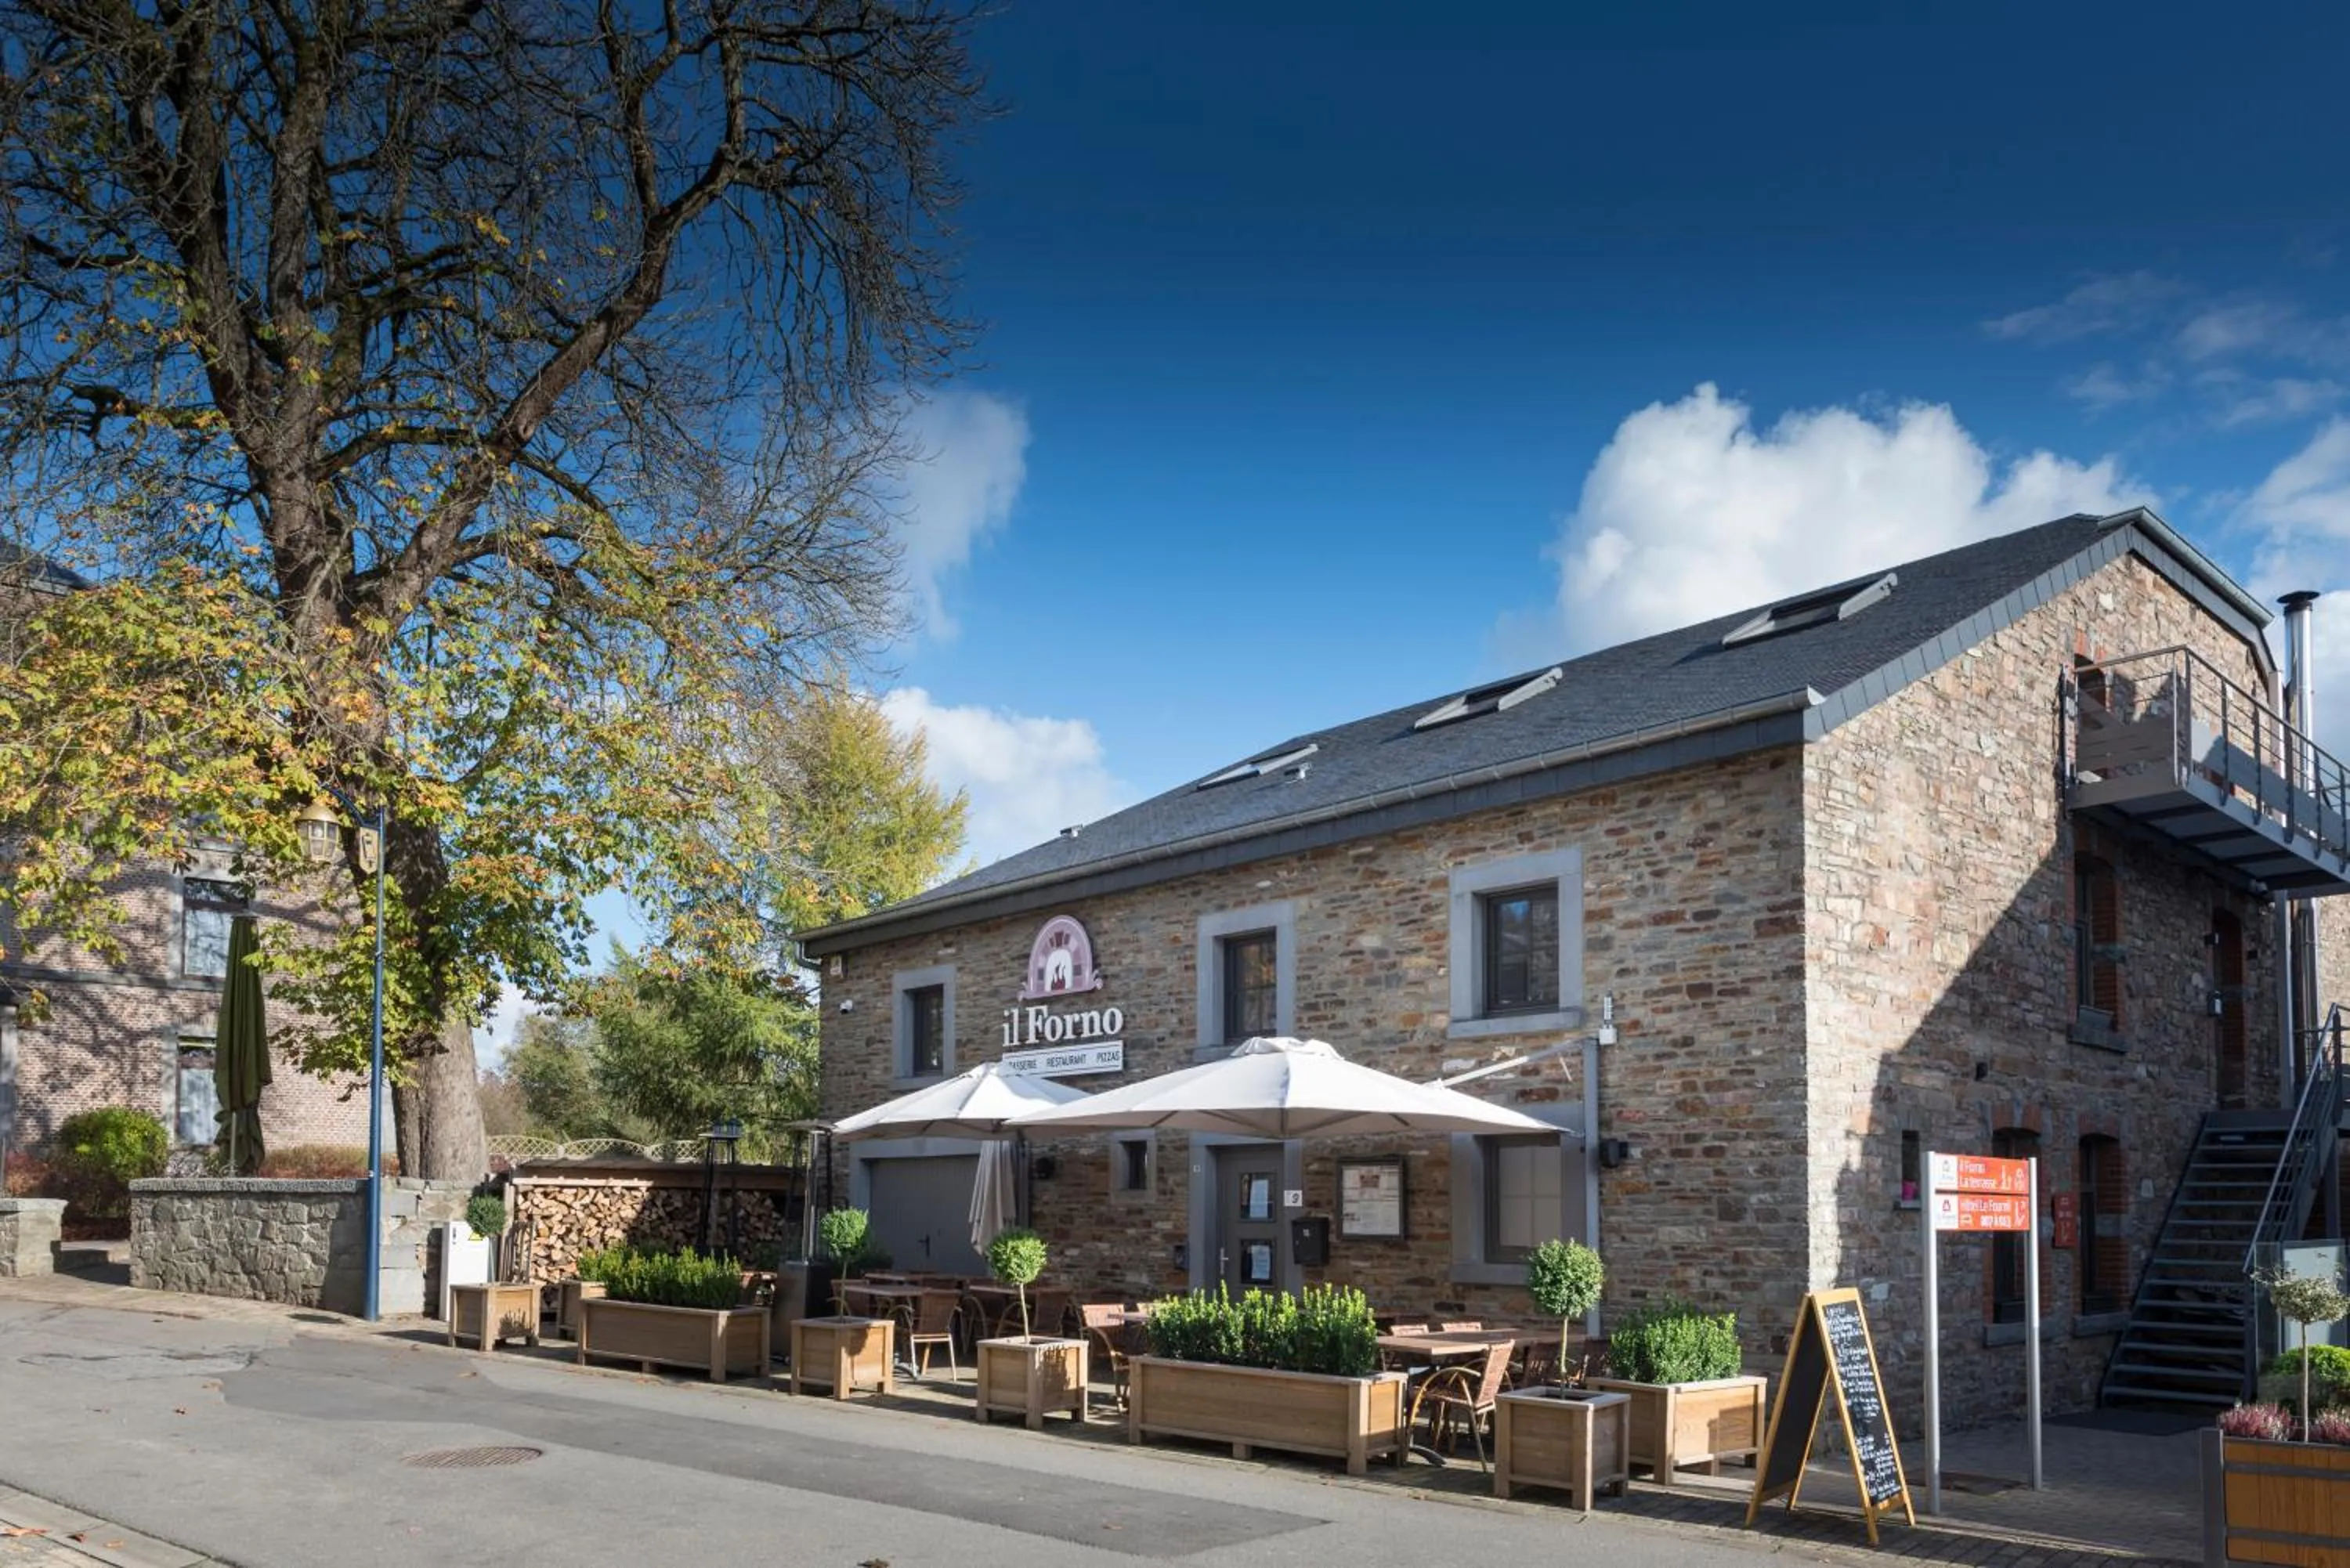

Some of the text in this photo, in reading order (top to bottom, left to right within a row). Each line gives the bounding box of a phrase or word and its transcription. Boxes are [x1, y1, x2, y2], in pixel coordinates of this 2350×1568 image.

[1003, 1005, 1123, 1046] il Forno
[1047, 1054, 1086, 1068] RESTAURANT
[1097, 1051, 1120, 1063] PIZZAS
